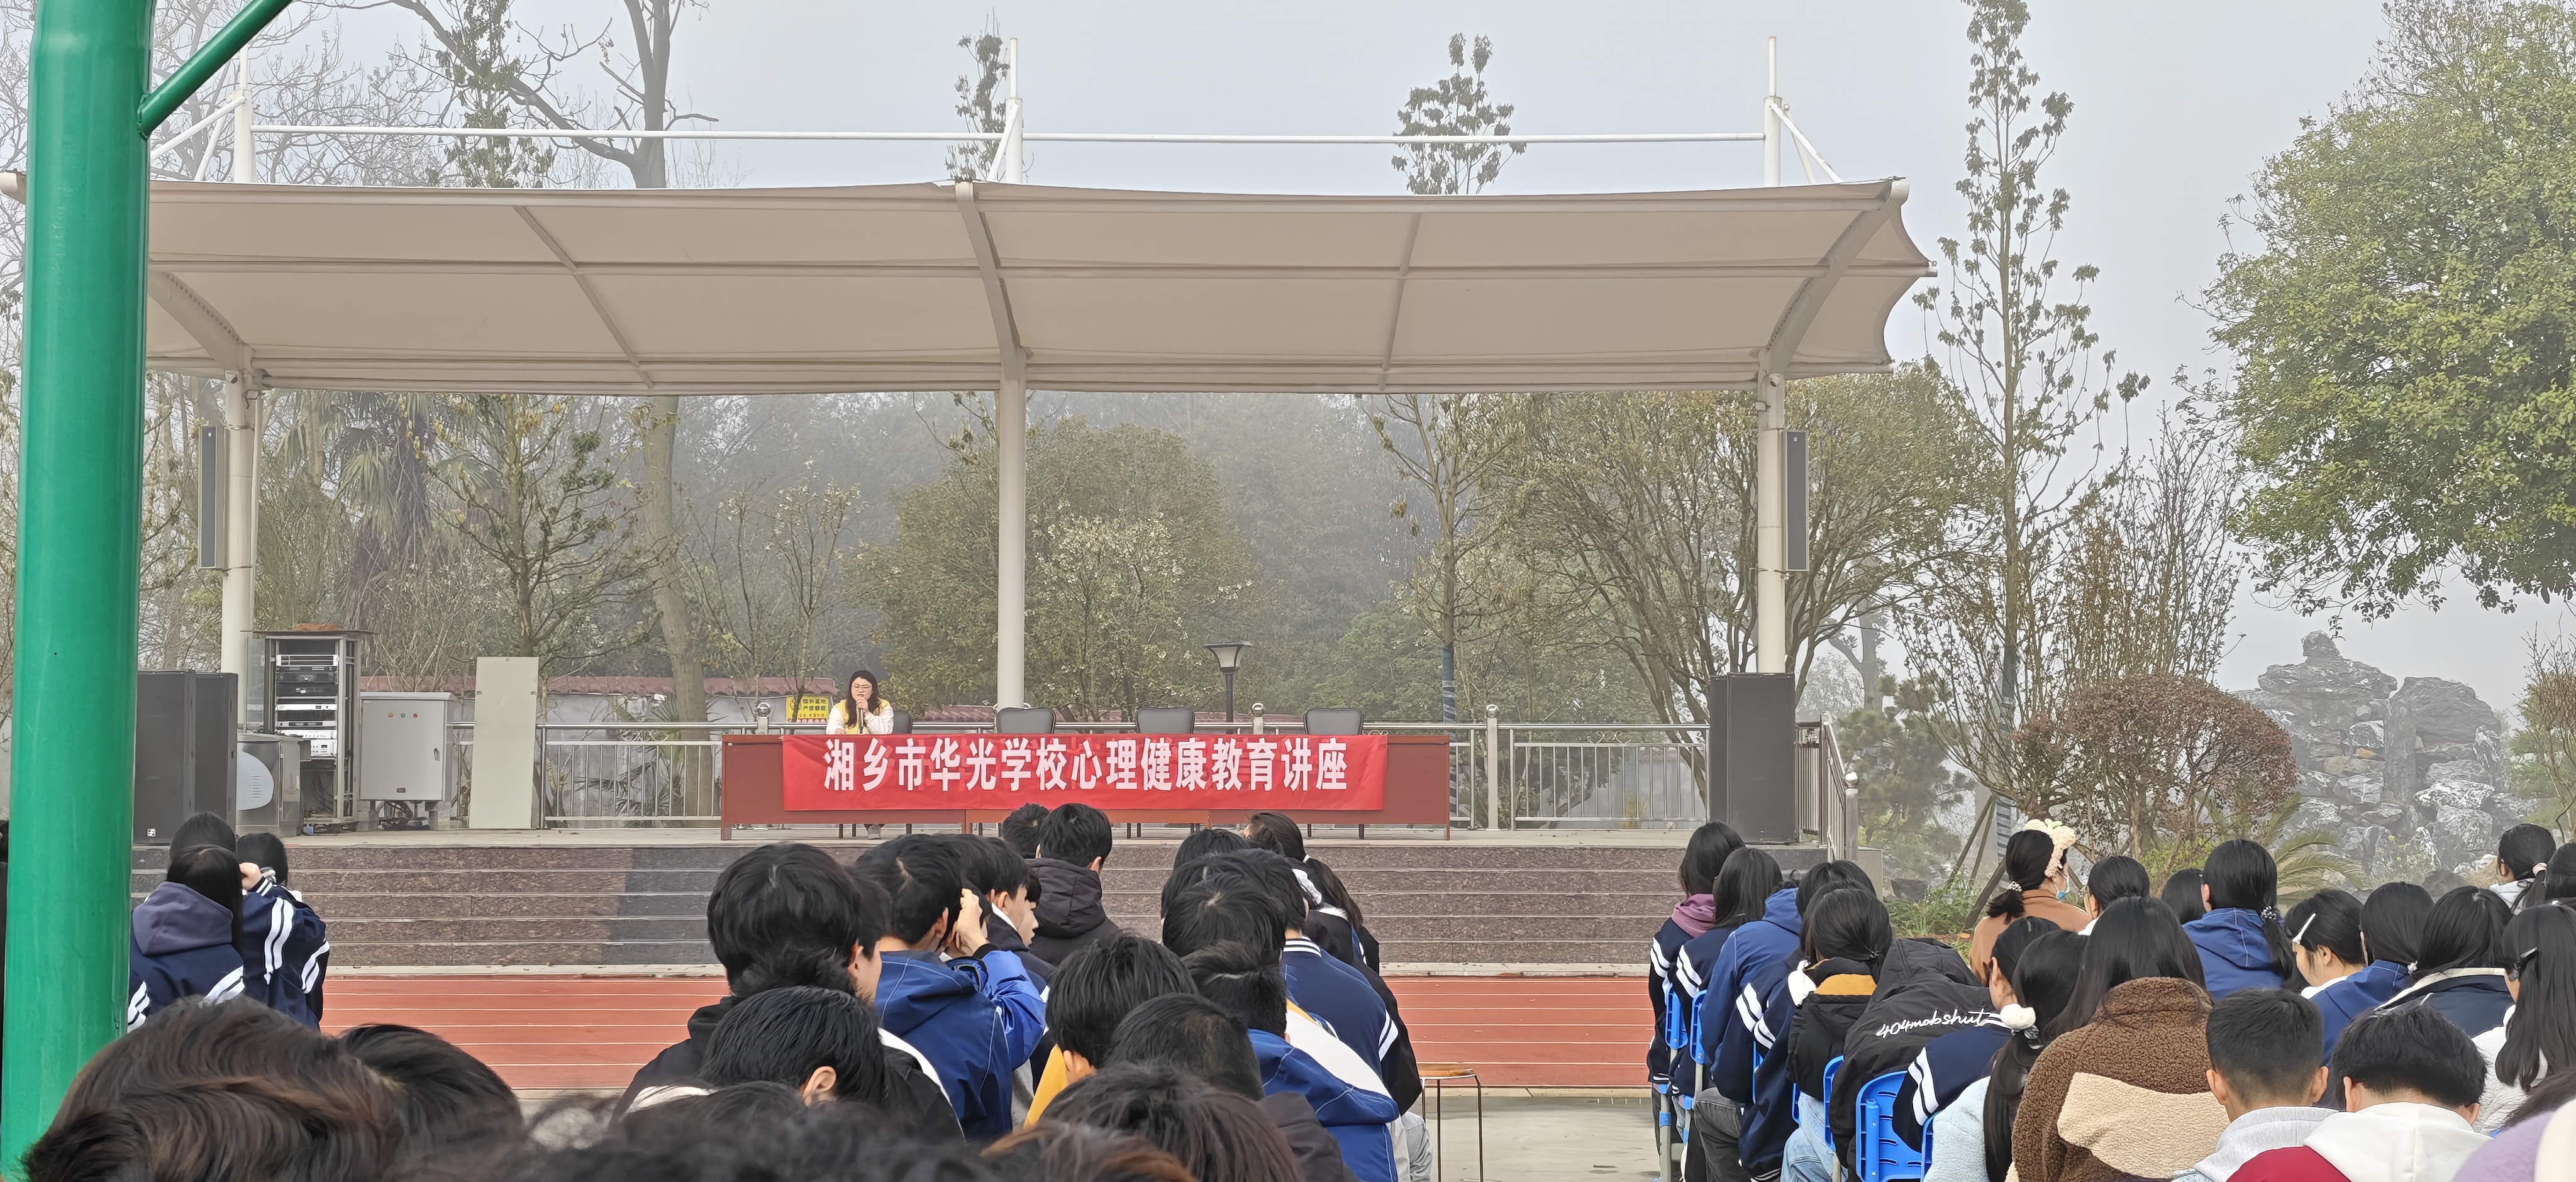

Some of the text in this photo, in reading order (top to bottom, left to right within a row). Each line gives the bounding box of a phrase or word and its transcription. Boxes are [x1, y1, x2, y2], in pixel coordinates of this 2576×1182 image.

[823, 737, 1348, 792] 湘乡市华光学校心理健康教育讲座
